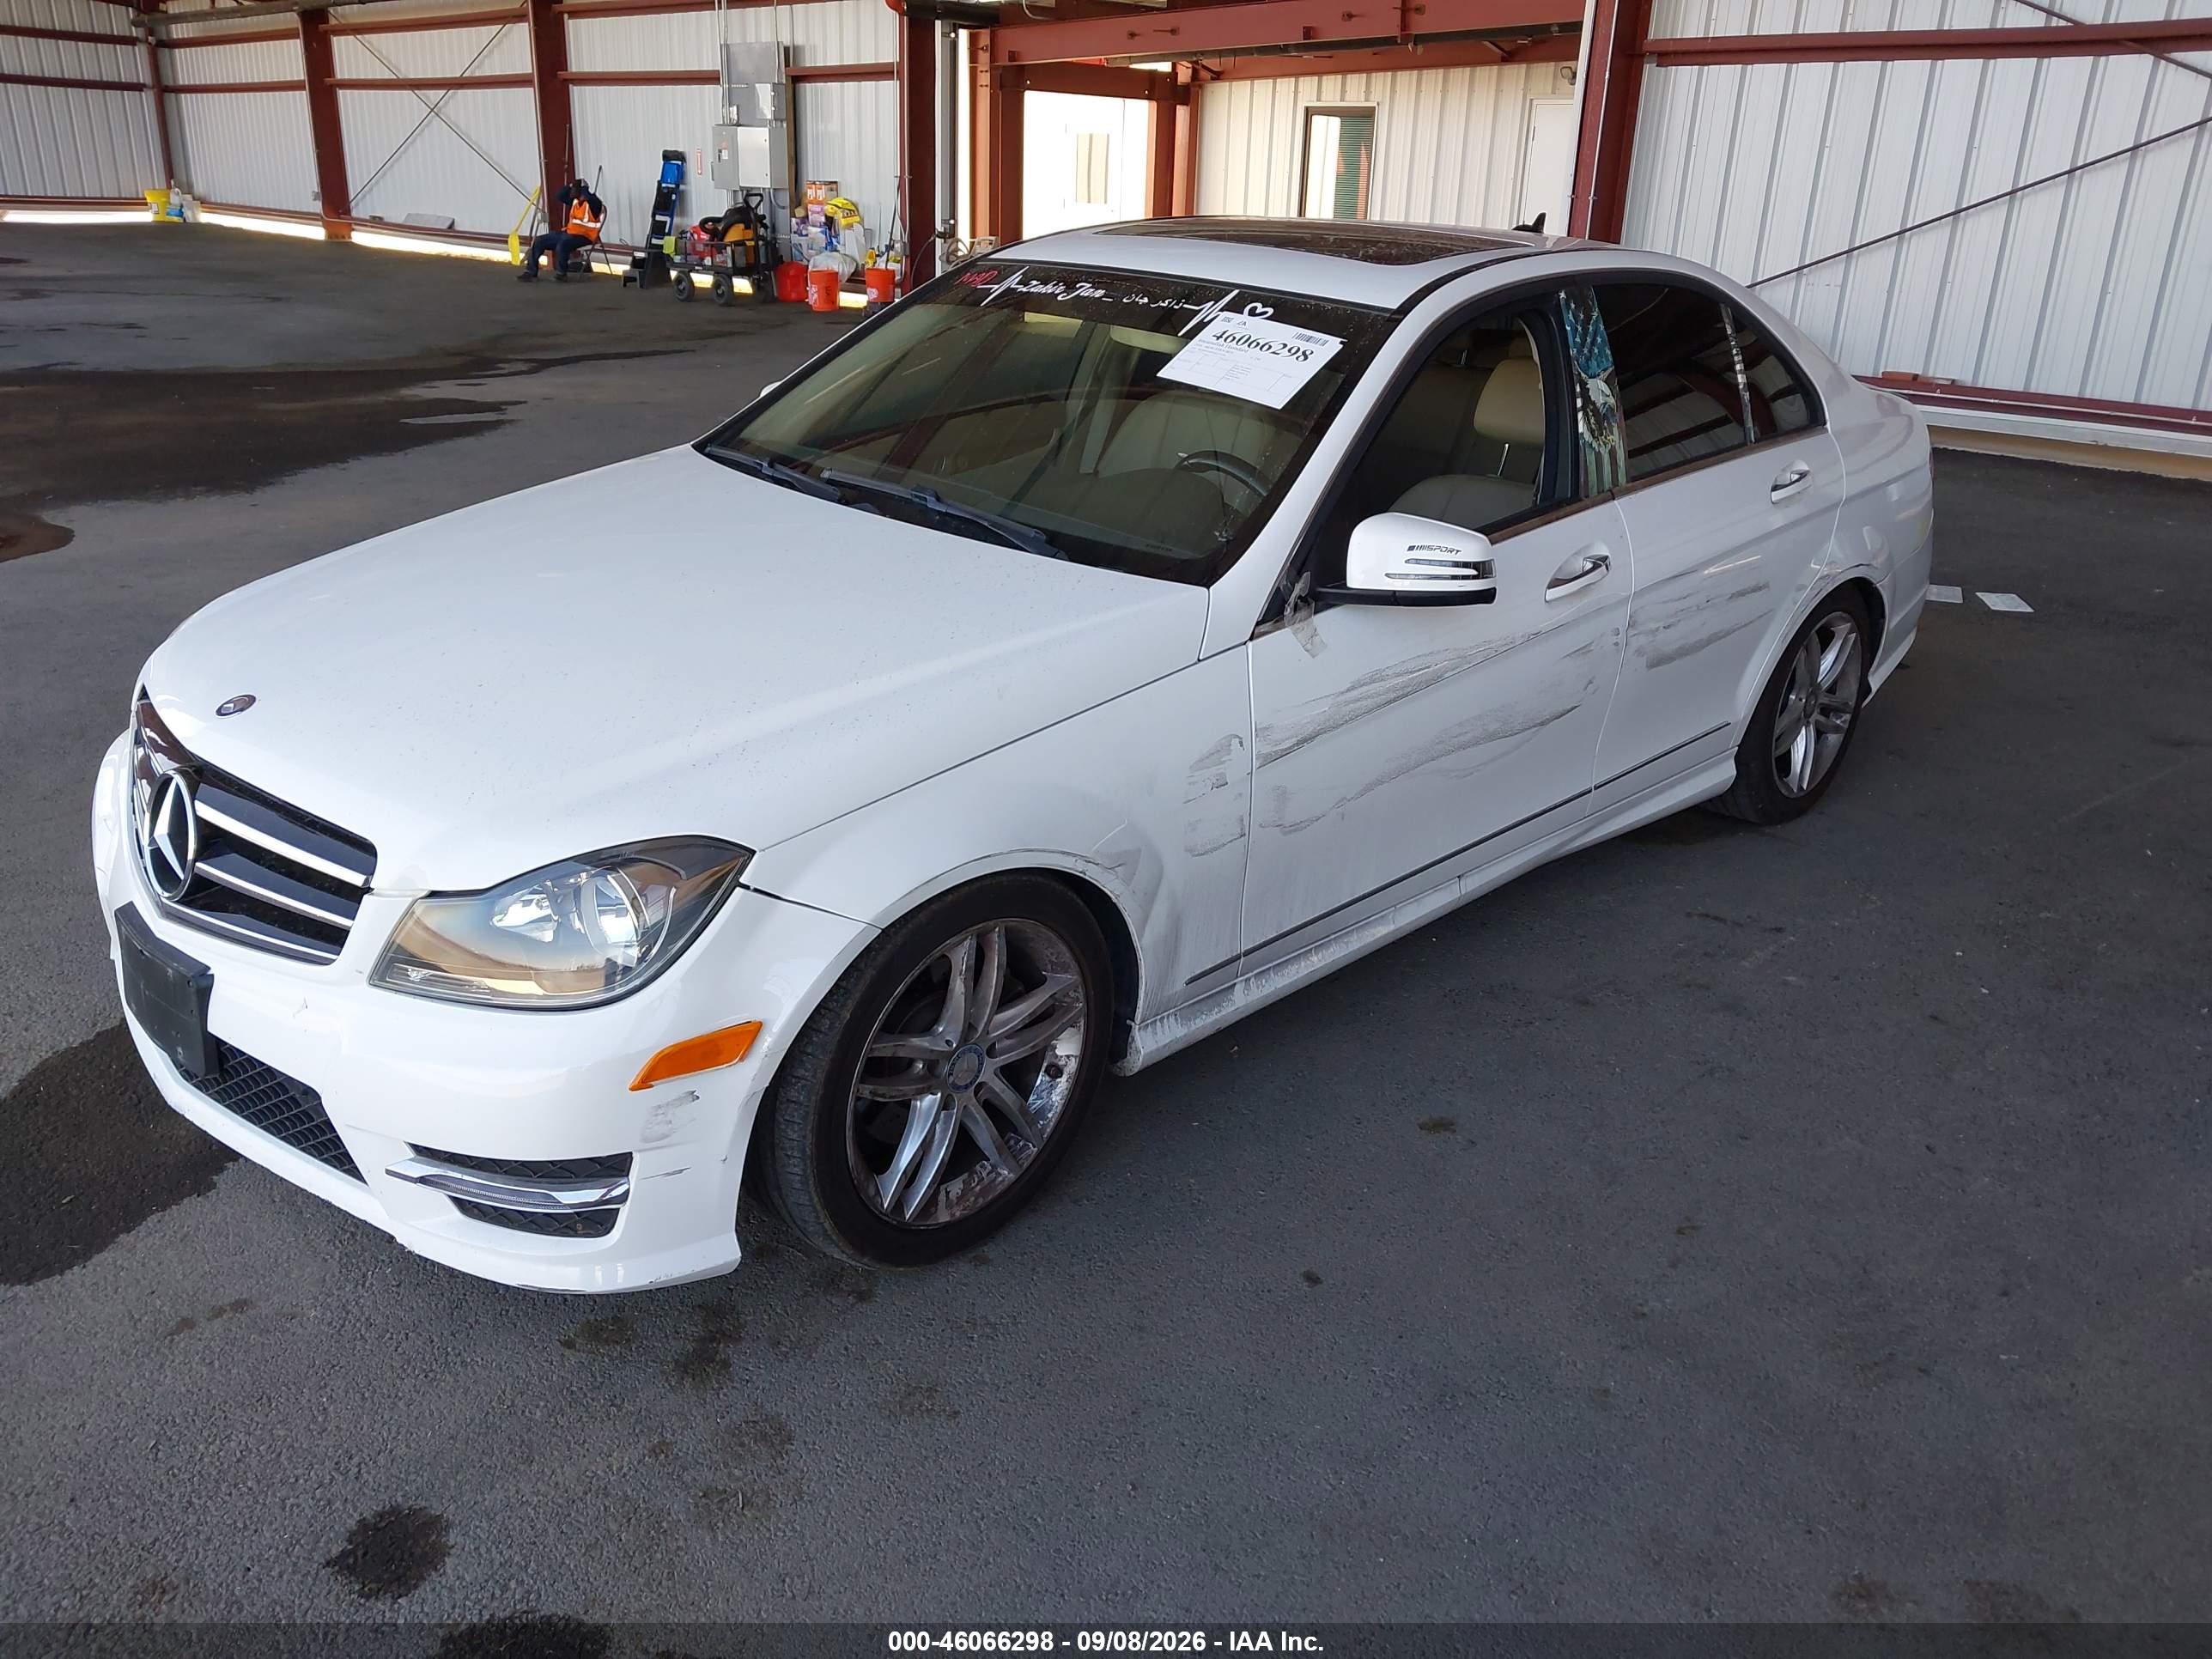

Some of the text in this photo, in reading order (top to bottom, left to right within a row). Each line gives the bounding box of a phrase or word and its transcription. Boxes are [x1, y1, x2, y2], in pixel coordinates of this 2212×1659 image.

[1018, 280, 1107, 301] Zakir Jan
[1212, 329, 1315, 362] 46066298
[1426, 544, 1462, 556] SPORT
